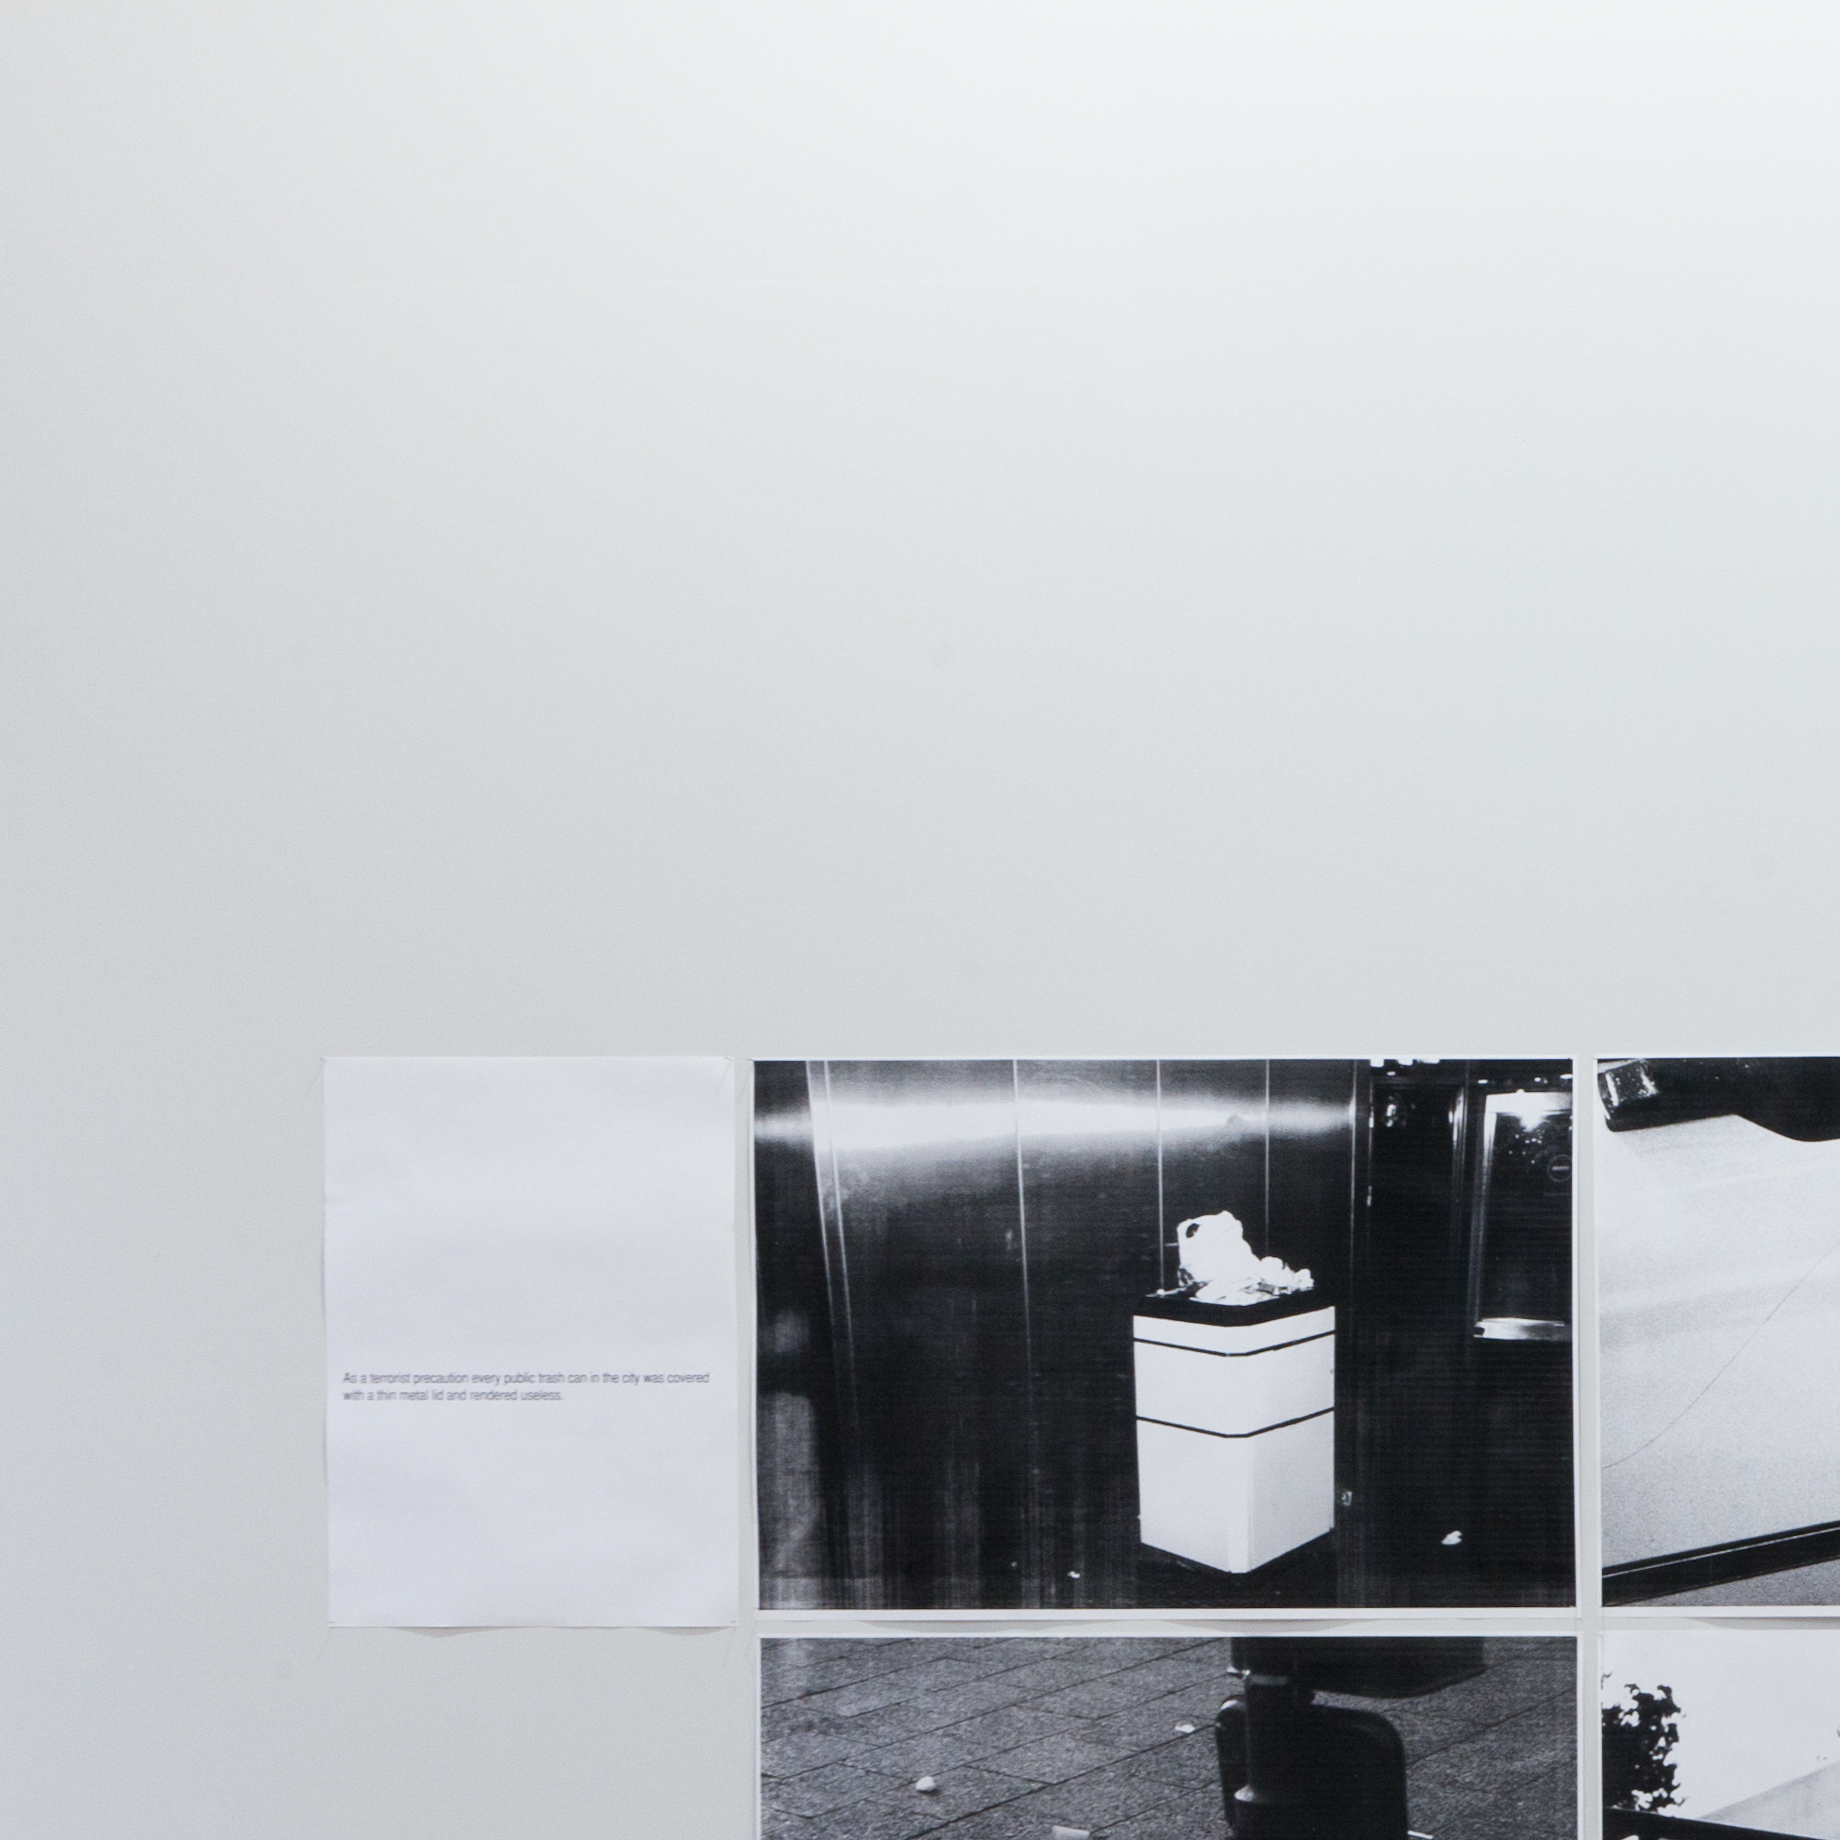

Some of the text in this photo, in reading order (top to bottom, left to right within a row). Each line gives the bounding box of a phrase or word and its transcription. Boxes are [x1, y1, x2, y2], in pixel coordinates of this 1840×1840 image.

[342, 1371, 711, 1386] As a terrorist precaution every public trash can in the city was covered
[342, 1388, 566, 1401] with a thin metal lid and rendered useless.
